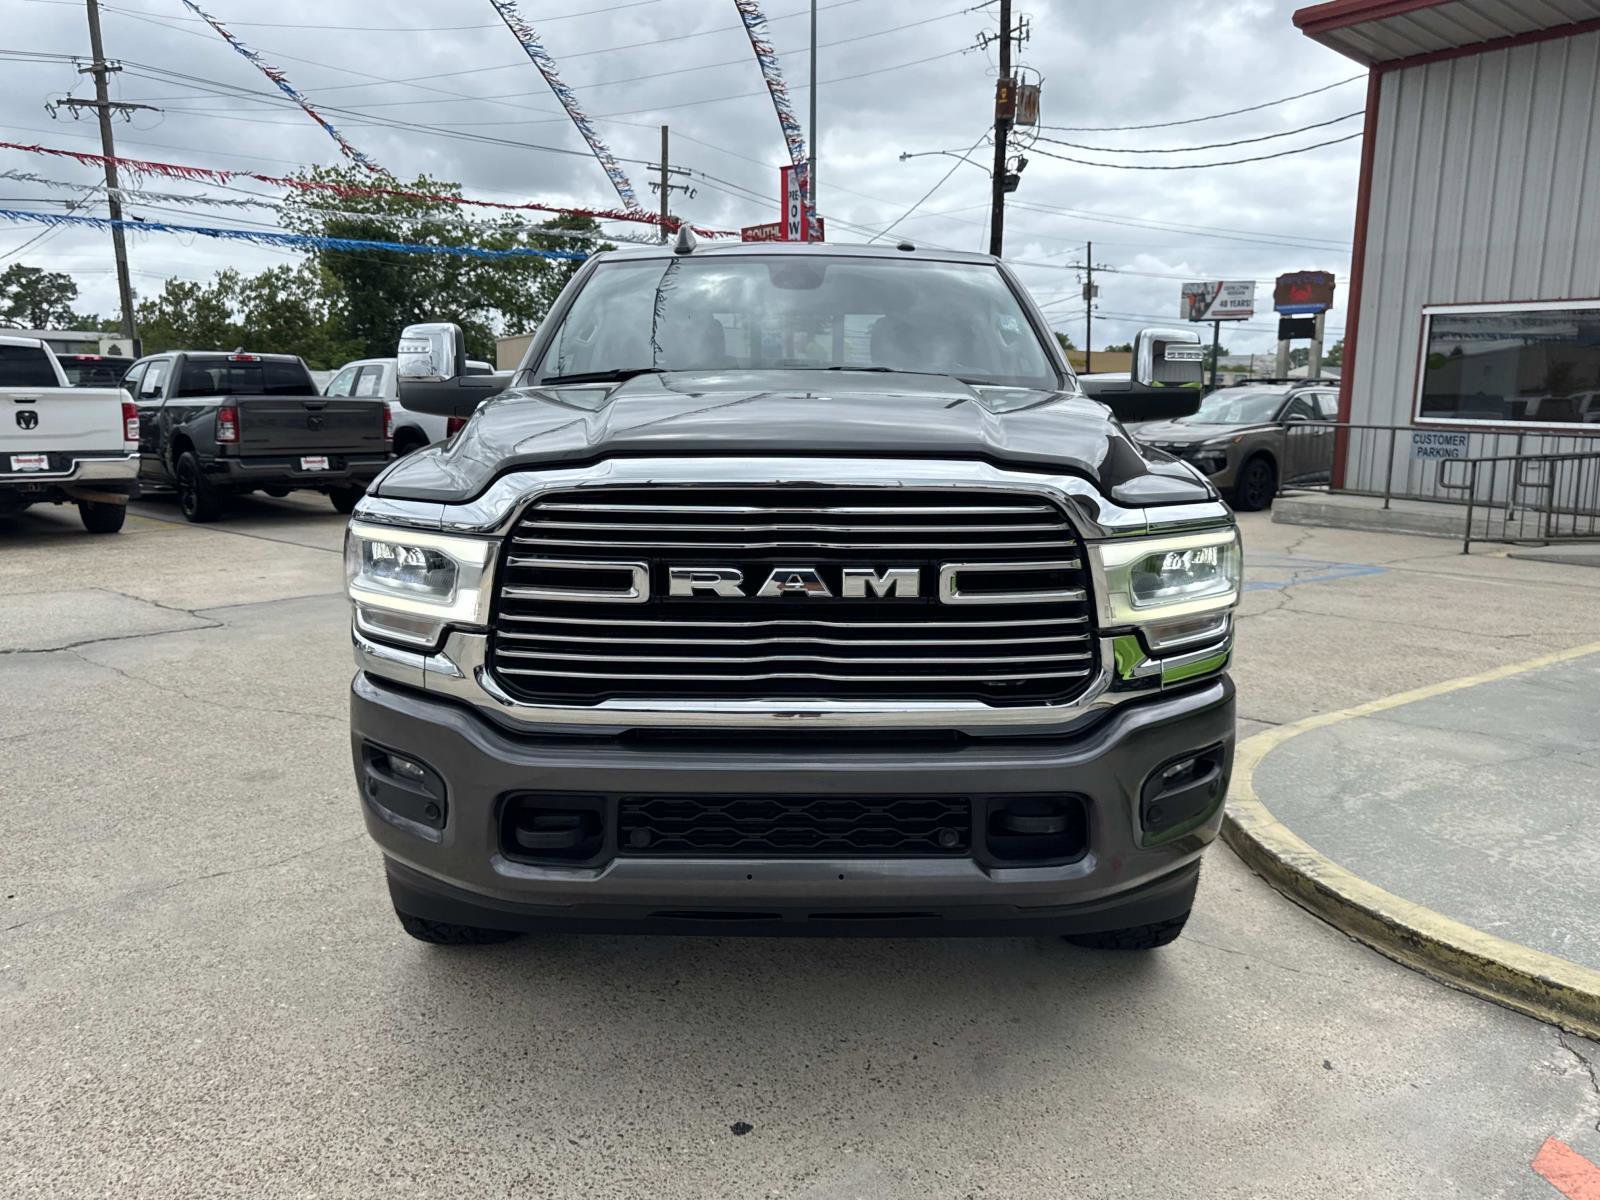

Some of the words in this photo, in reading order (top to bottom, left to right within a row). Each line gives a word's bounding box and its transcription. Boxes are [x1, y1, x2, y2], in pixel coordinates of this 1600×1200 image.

[1412, 433, 1466, 446] CUSTOMER
[1416, 446, 1460, 458] PARKING
[669, 567, 921, 598] RAM
